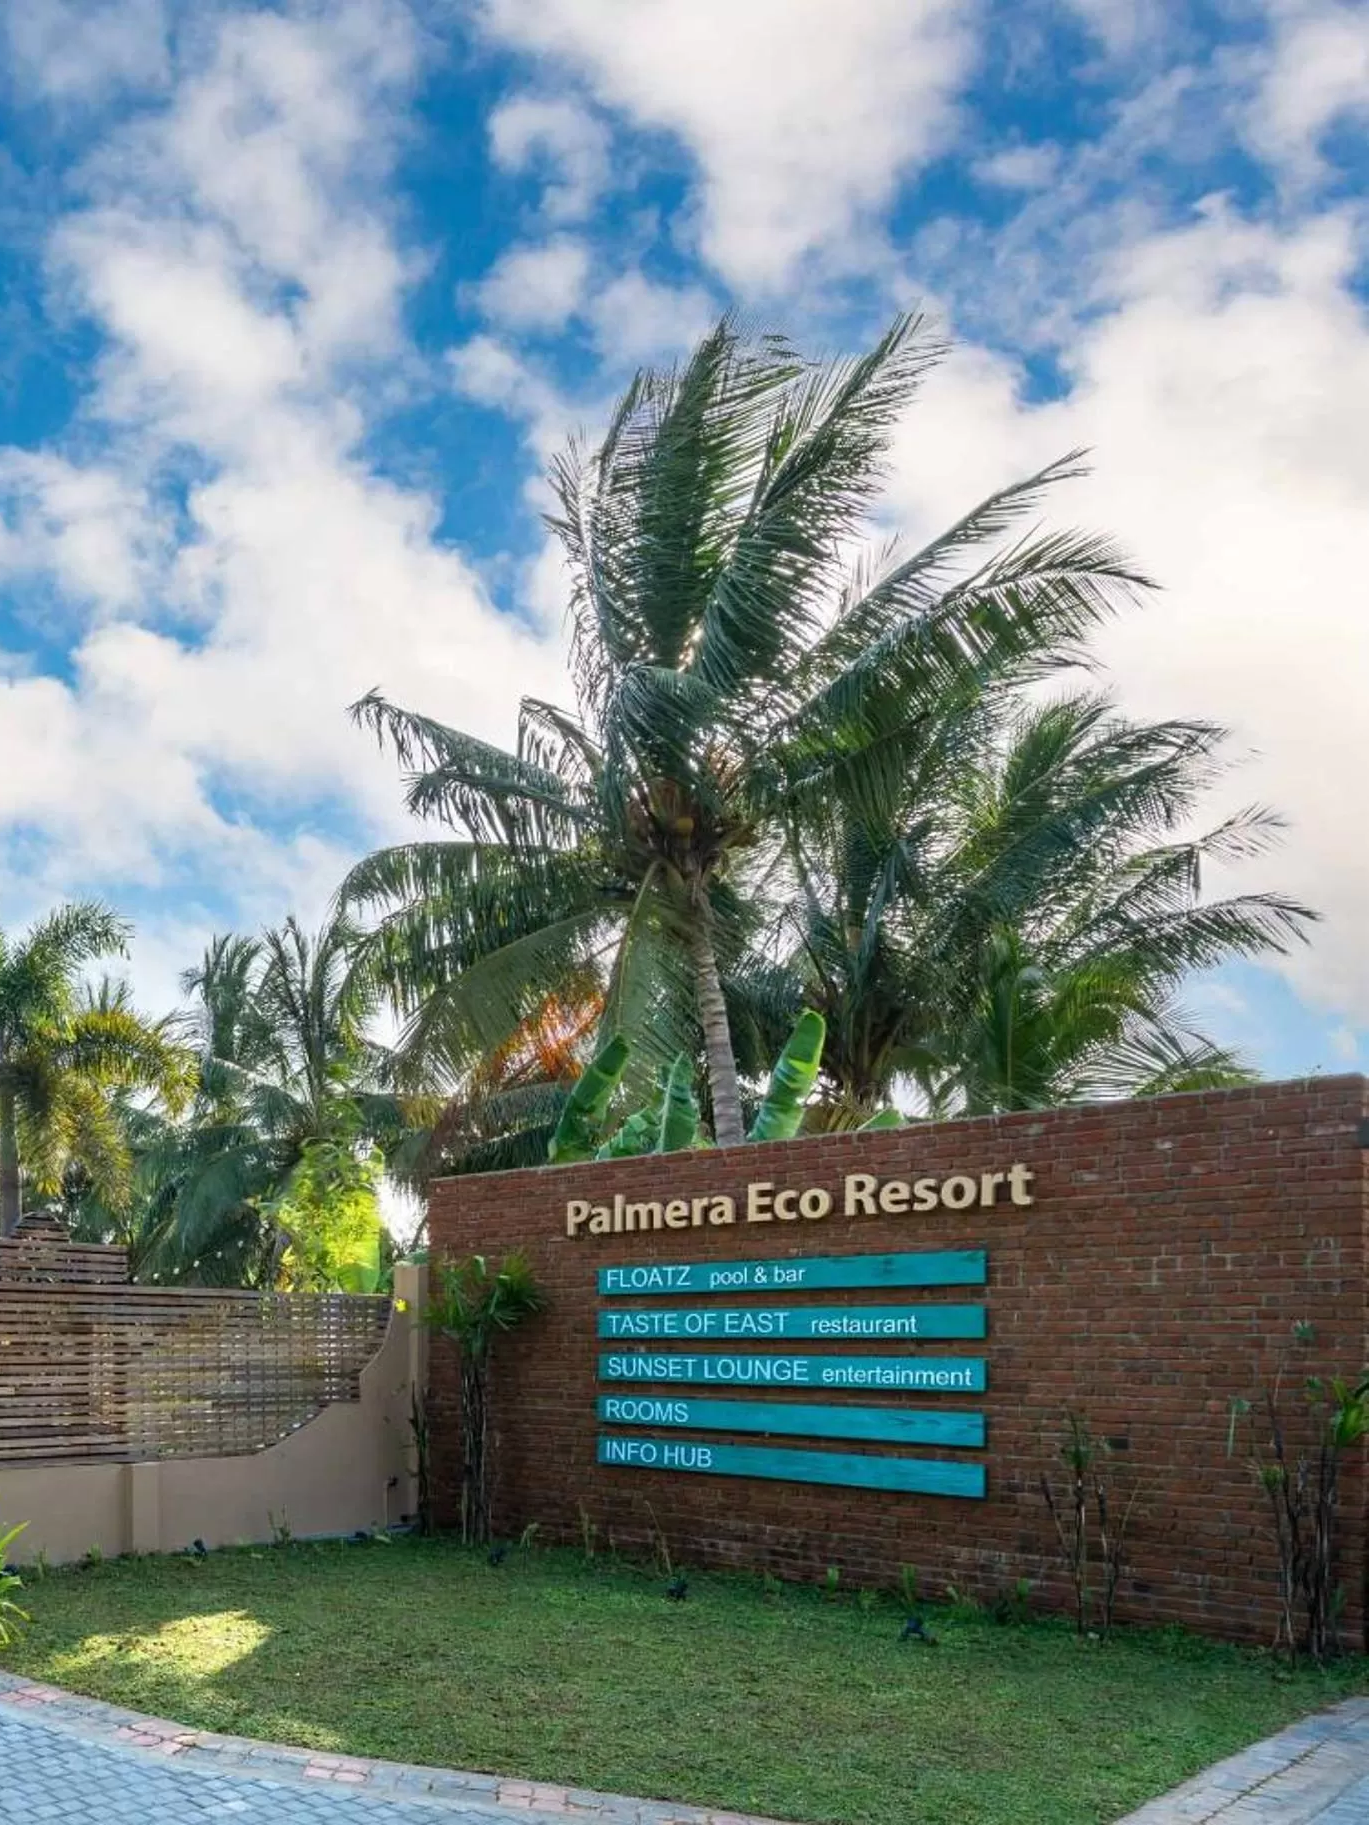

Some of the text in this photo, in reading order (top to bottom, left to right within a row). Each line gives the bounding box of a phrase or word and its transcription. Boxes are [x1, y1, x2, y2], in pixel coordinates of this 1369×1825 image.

[566, 1163, 1034, 1236] Palmera Eco Resort
[607, 1265, 805, 1289] FLOATZ pool & bar
[609, 1312, 917, 1334] TASTE OF EAST restaurant
[607, 1356, 972, 1387] SUNSET LOUNGE entertainment
[606, 1399, 689, 1424] ROOMS
[605, 1440, 712, 1468] INFO HUB
